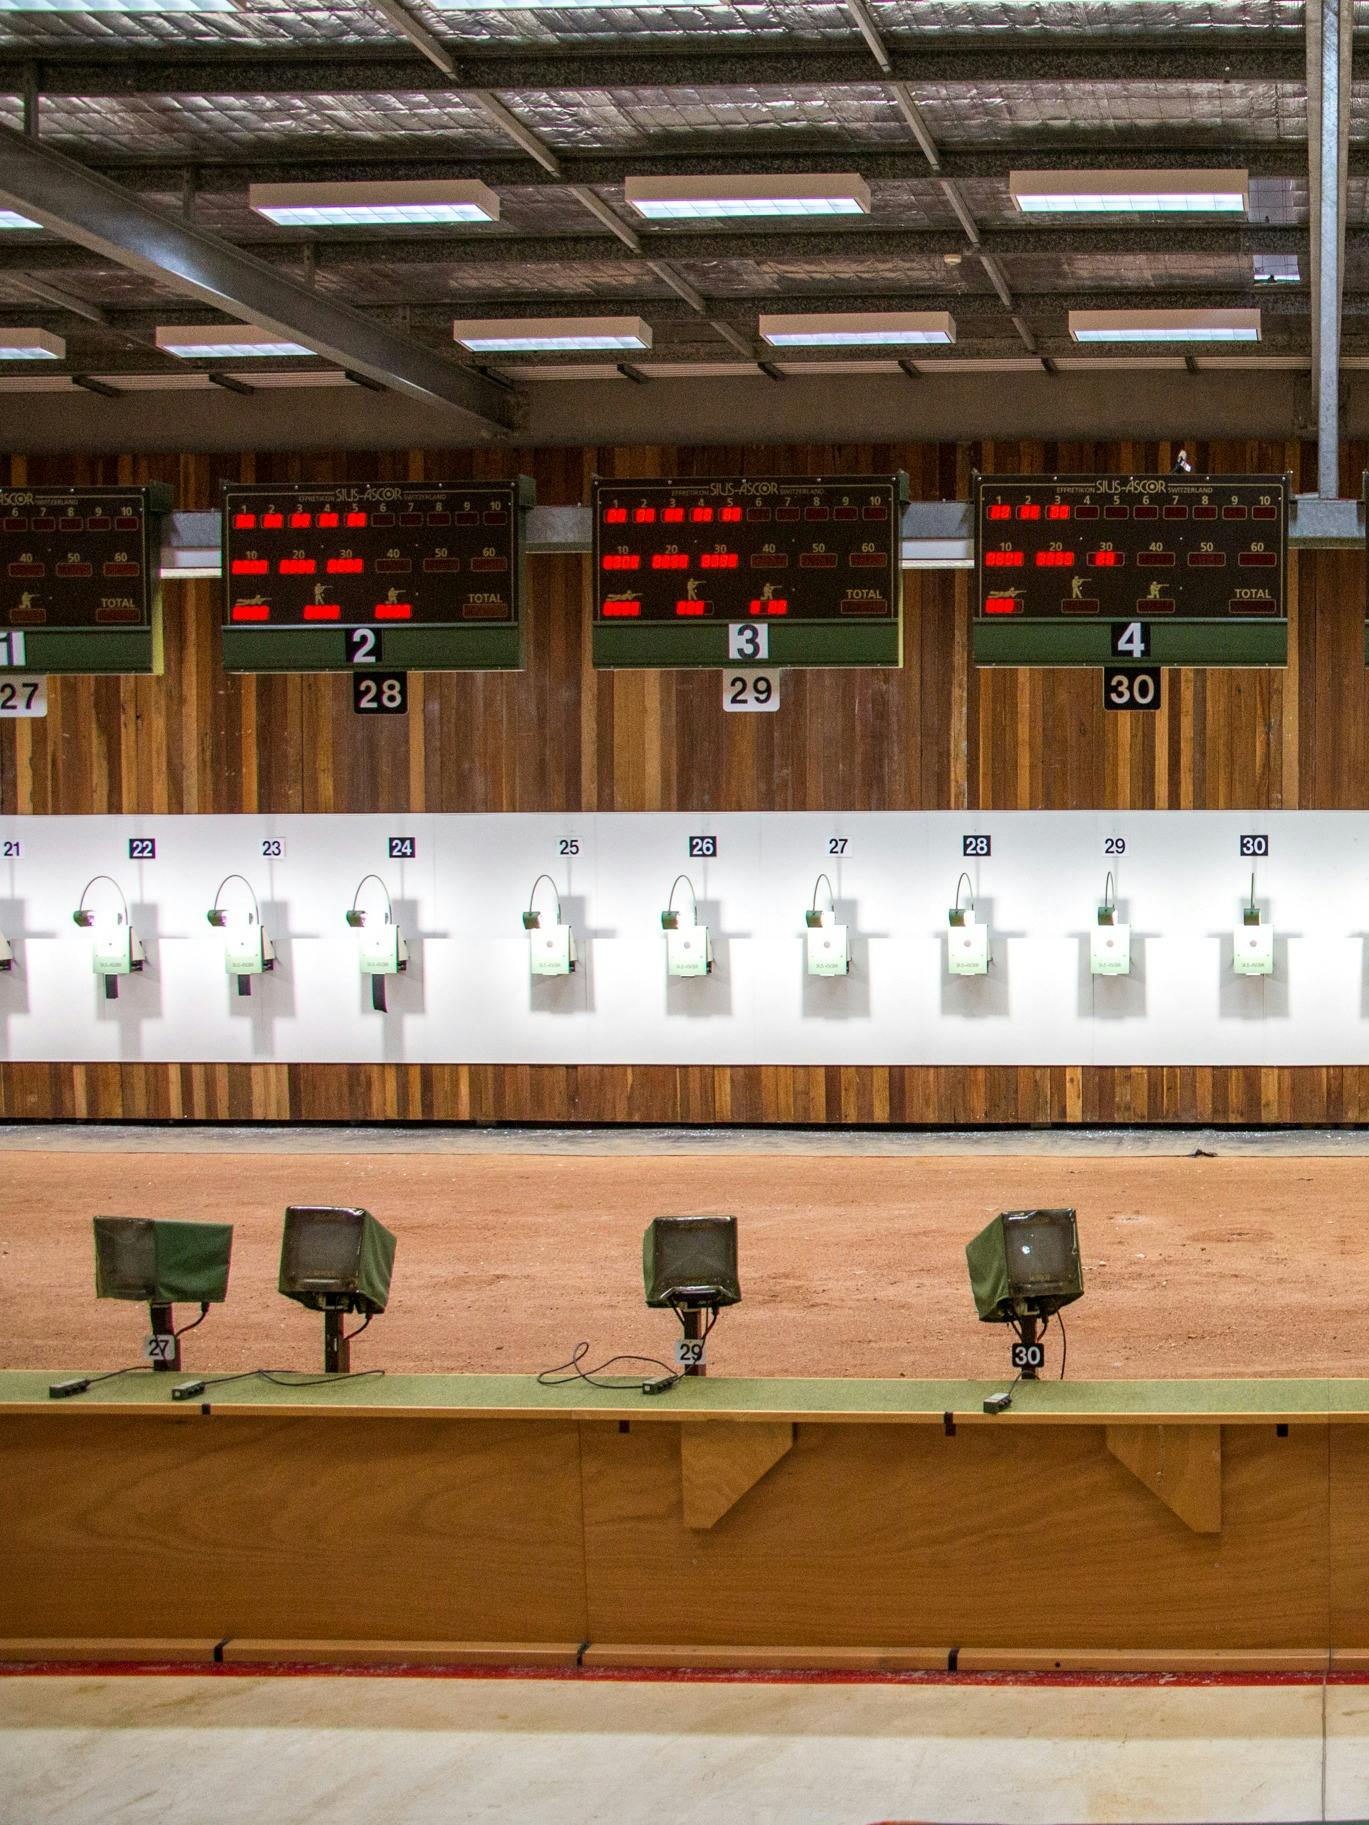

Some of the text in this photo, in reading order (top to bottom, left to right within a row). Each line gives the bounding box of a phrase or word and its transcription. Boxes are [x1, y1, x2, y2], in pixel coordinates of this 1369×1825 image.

[755, 496, 881, 507] 6 7 8 9 10
[1083, 496, 1090, 505] 4
[1113, 496, 1120, 505] 5
[1142, 496, 1150, 506] 6
[1172, 496, 1179, 506] 7
[1201, 496, 1209, 506] 8
[1231, 496, 1238, 506] 9
[1259, 496, 1271, 506] 10
[762, 543, 875, 554] 40 50 60
[999, 542, 1264, 552] 10 20 30 40 50 60
[468, 593, 503, 603] TOTAL
[846, 589, 882, 600] TOTAL
[1235, 588, 1271, 599] TOTAL
[101, 598, 135, 608] TOTAL
[352, 629, 377, 662] 2
[737, 624, 759, 659] 3
[1117, 623, 1145, 658] 4
[1, 683, 39, 709] 27
[359, 680, 402, 708] 28
[730, 677, 772, 704] 29
[1110, 675, 1155, 704] 30
[4, 842, 19, 856] 21
[133, 841, 152, 856] 22
[263, 841, 281, 856] 23
[393, 840, 412, 855] 24
[560, 840, 579, 854] 25
[693, 839, 713, 854] 26
[830, 839, 848, 853] 27
[966, 838, 987, 854] 28
[1105, 839, 1125, 853] 29
[1243, 838, 1265, 854] 30
[148, 1340, 169, 1356] 27
[680, 1343, 702, 1361] 29
[1016, 1347, 1040, 1364] 30
